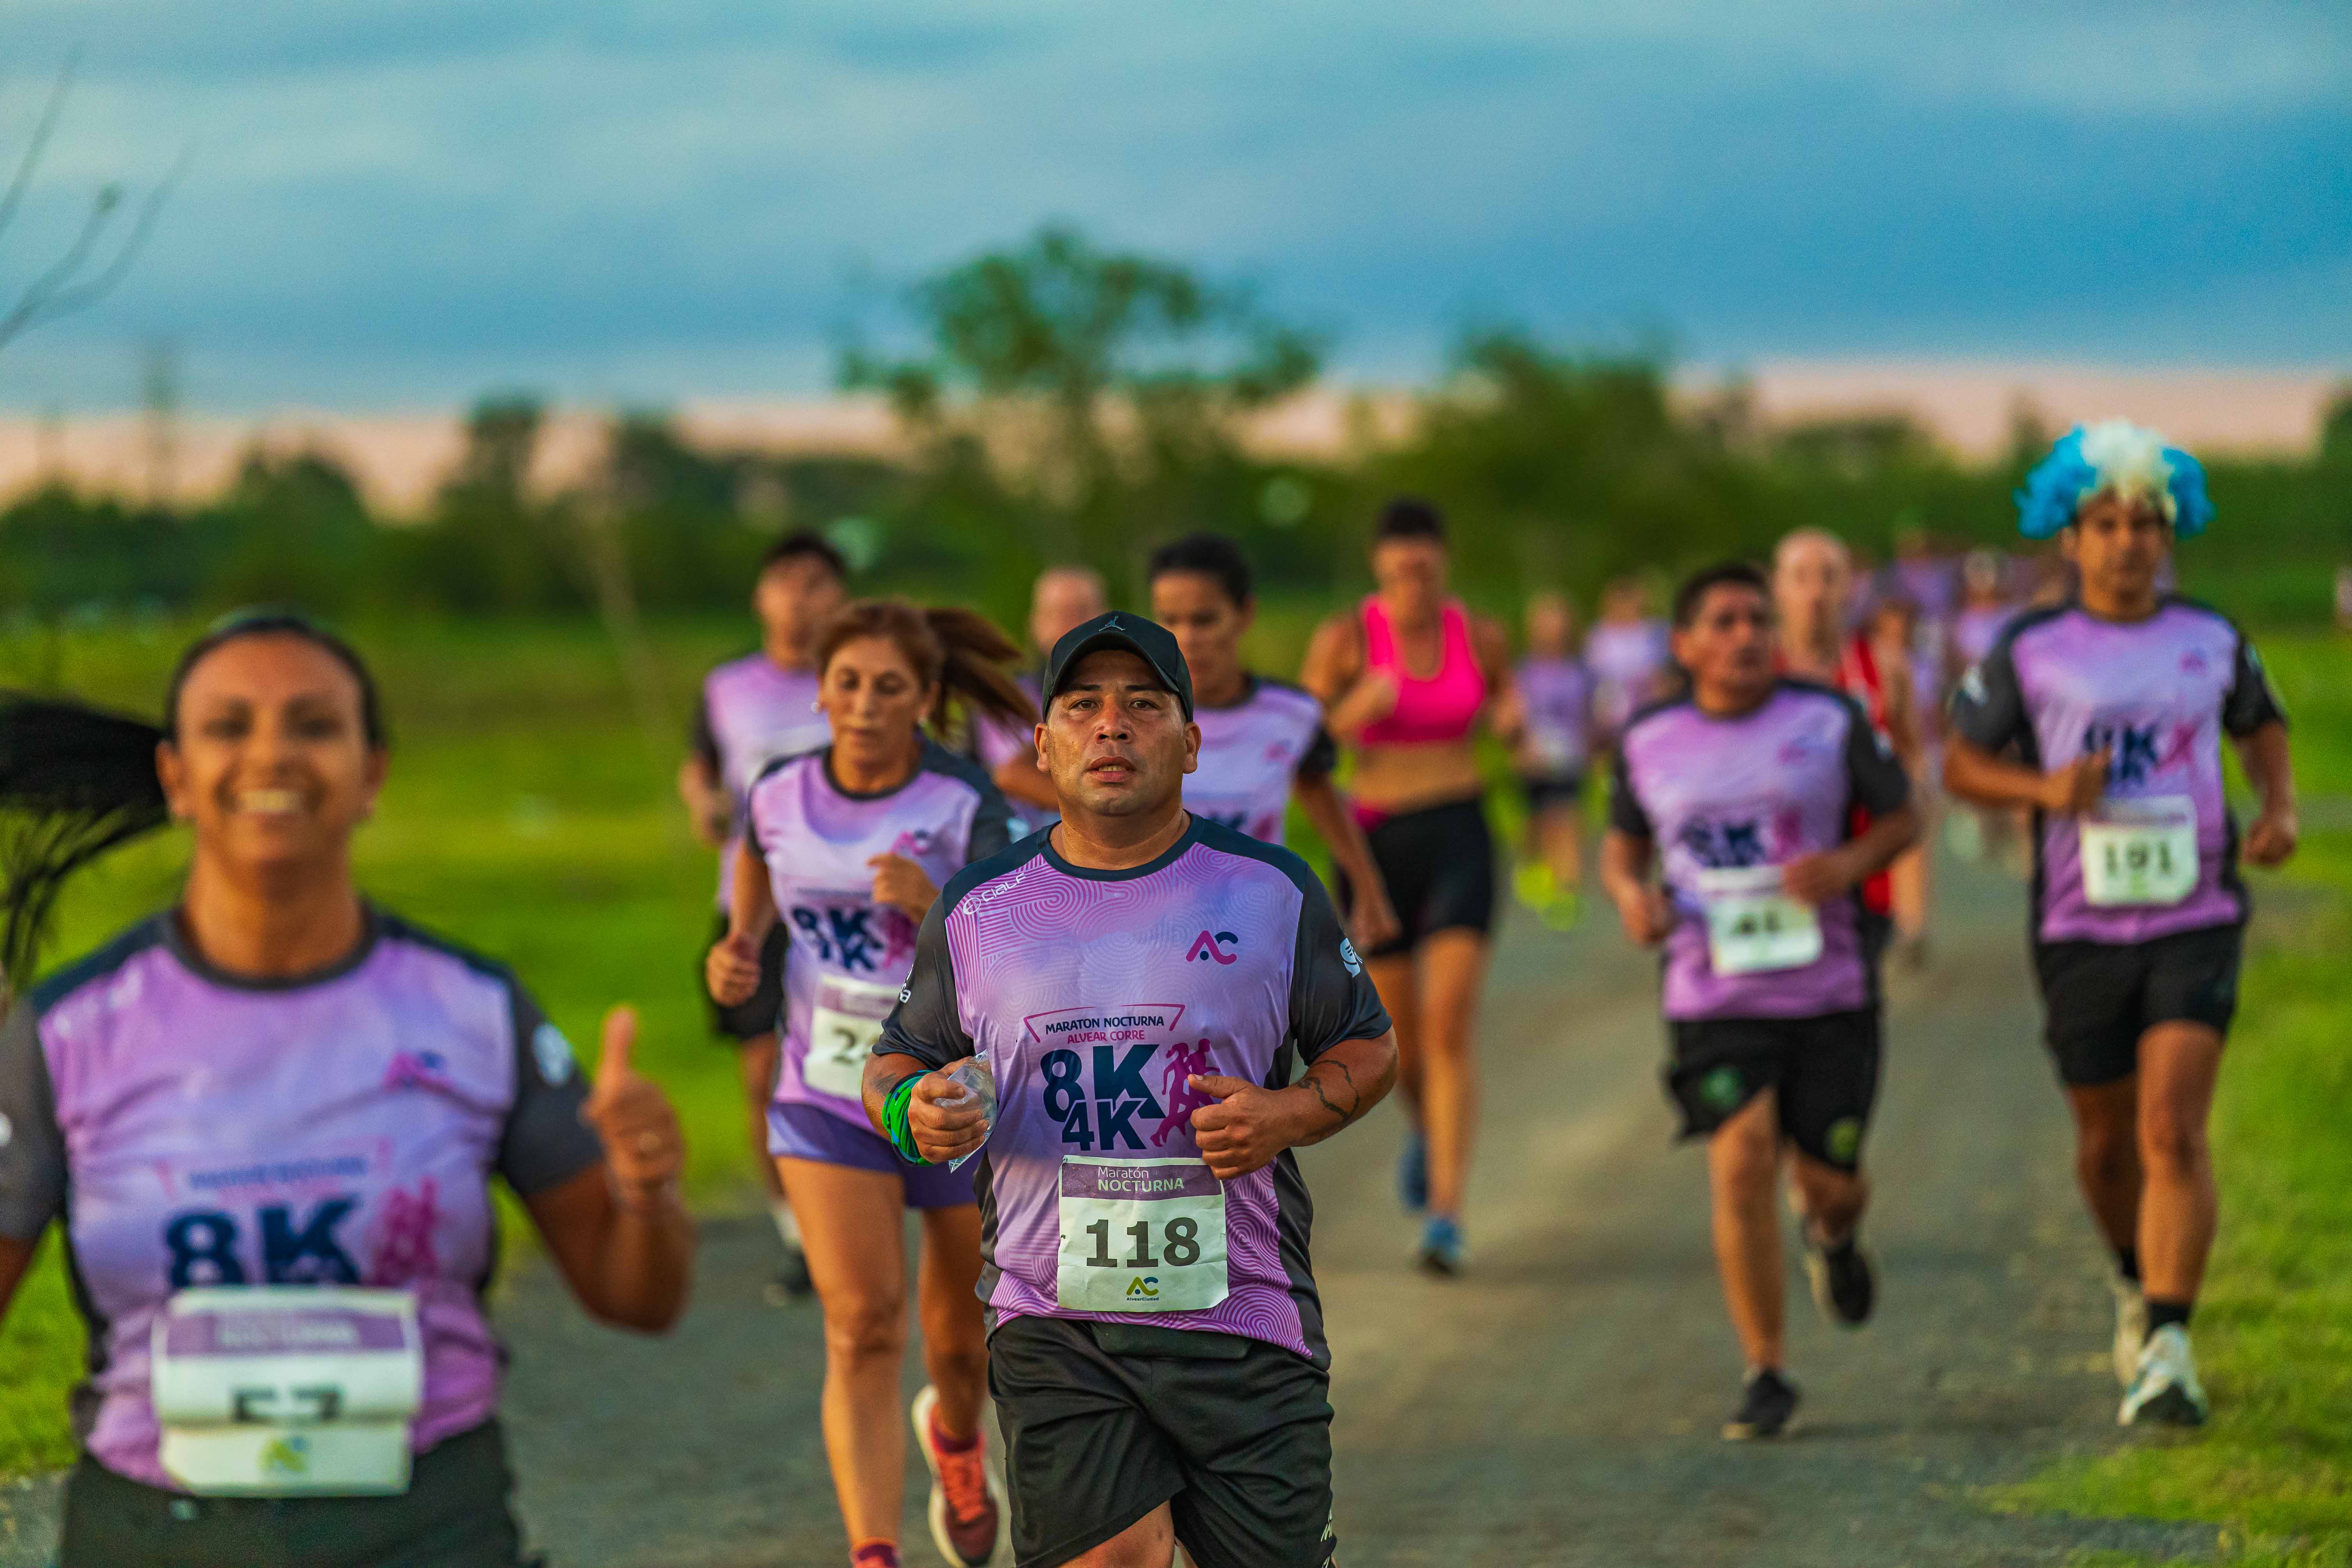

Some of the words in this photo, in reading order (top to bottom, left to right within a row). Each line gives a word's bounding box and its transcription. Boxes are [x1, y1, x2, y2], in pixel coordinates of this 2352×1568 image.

[1045, 1018, 1100, 1035] MARATON
[1103, 1016, 1164, 1028] NOCTURNA
[1067, 1031, 1107, 1045] ALVEAR
[1110, 1029, 1145, 1041] CORRE
[1040, 1044, 1166, 1123] 8K
[1061, 1100, 1147, 1151] 4K
[1098, 1166, 1149, 1179] Maratón
[1098, 1178, 1184, 1192] NOCTURNA
[1086, 1217, 1201, 1268] 118
